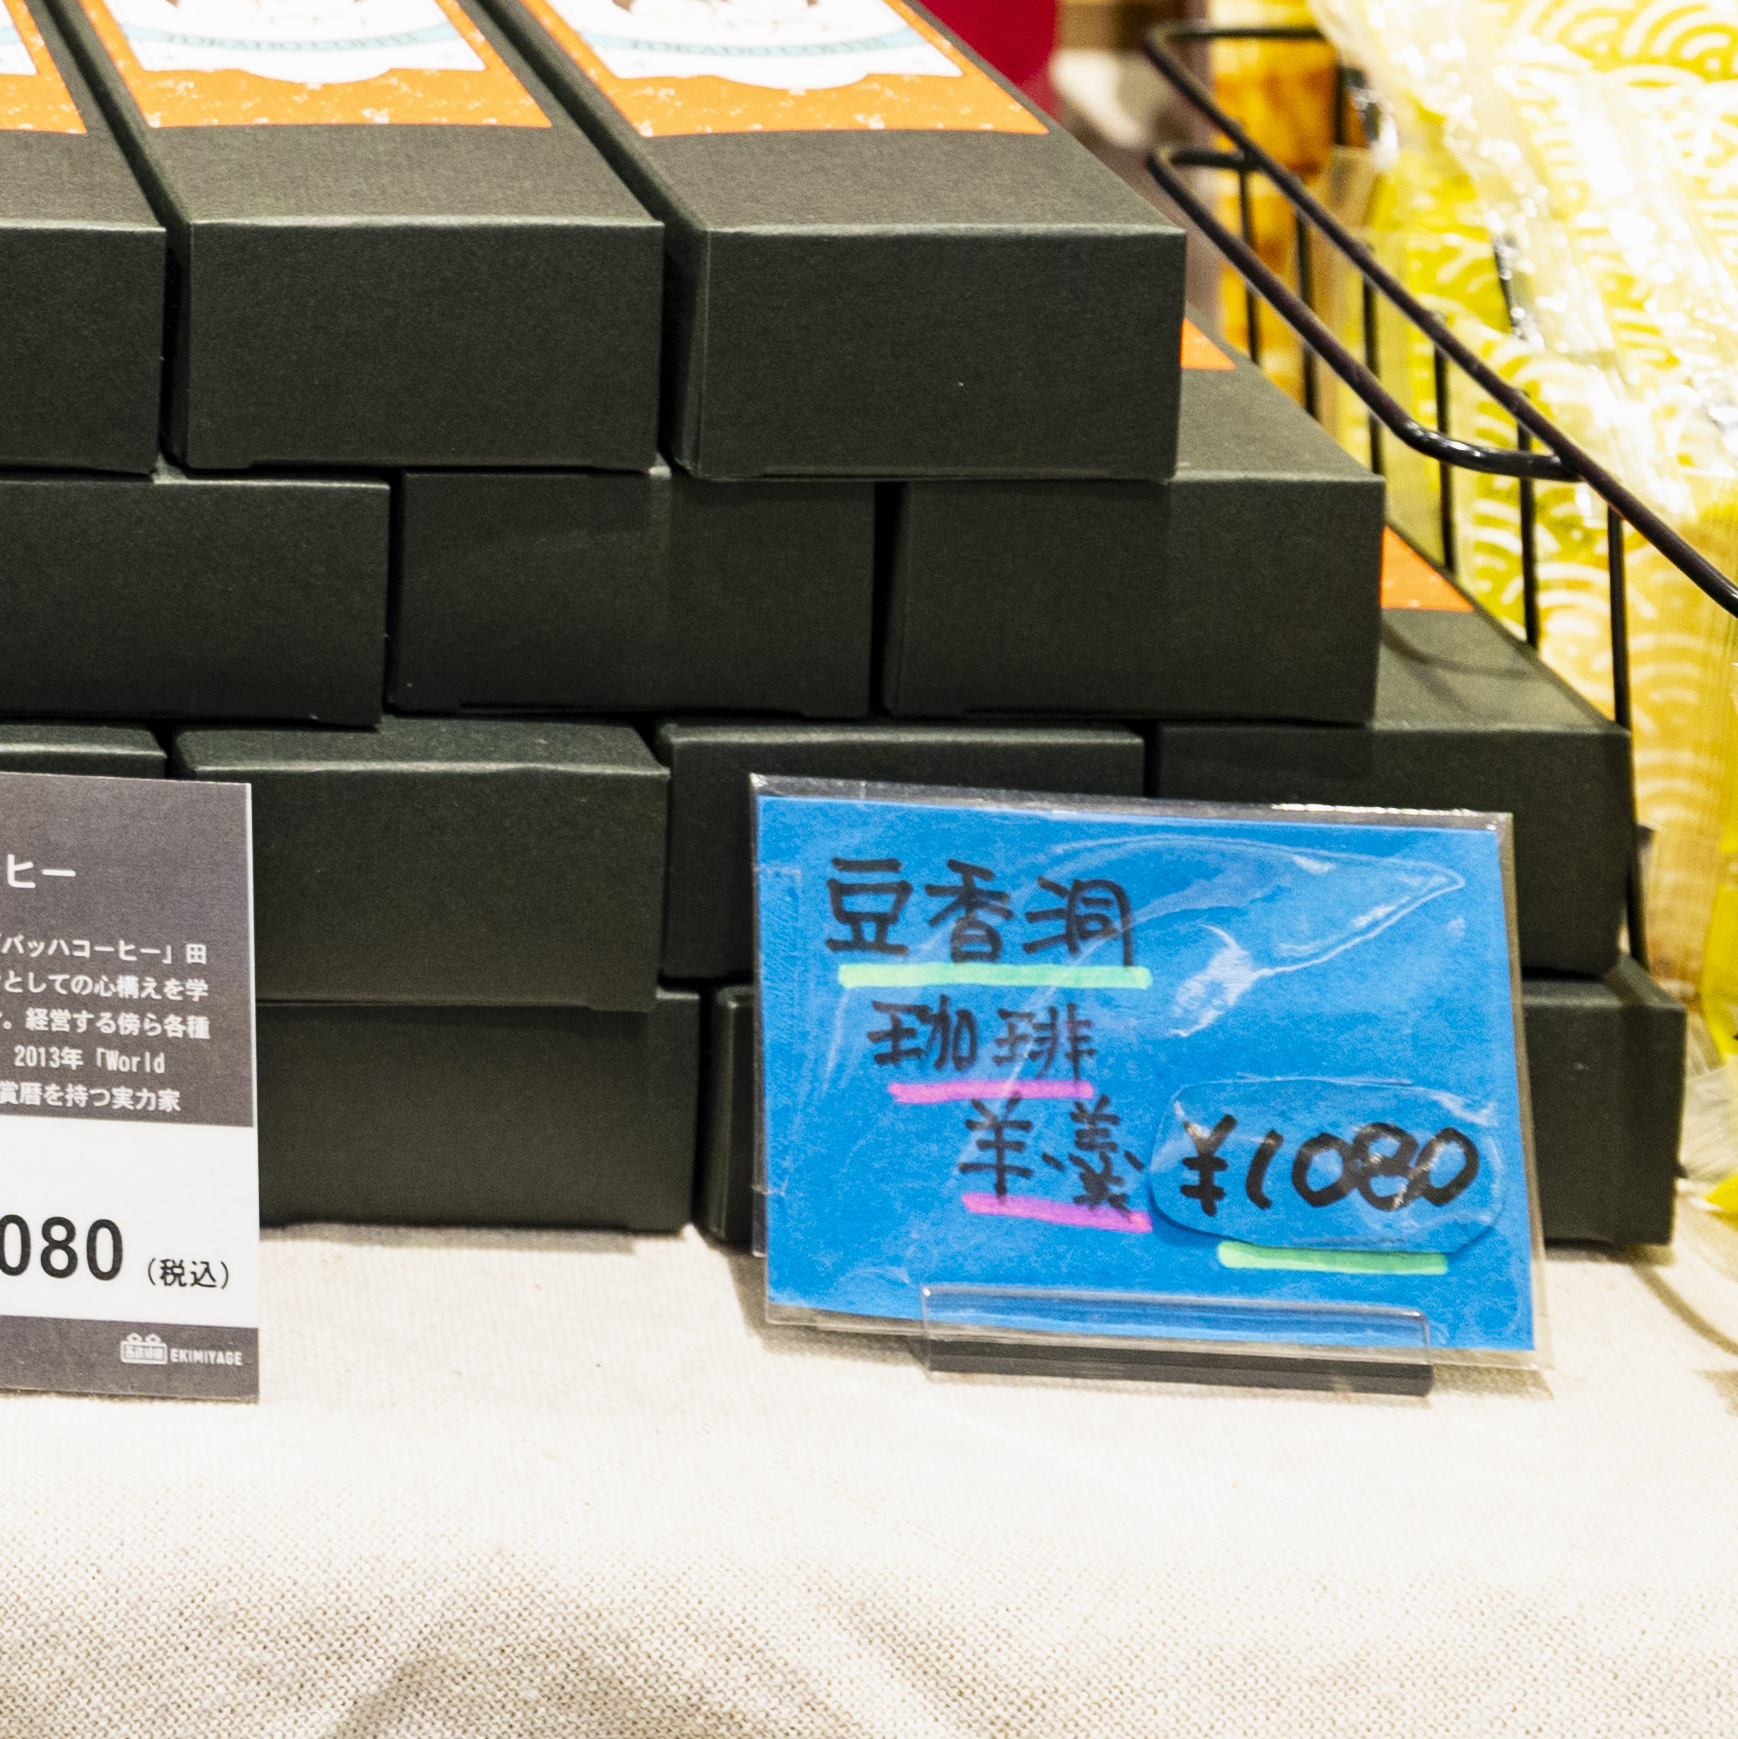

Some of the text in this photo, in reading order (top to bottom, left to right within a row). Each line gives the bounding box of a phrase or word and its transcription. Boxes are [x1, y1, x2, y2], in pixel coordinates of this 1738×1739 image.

[824, 858, 1136, 967] 豆香洞
[867, 995, 1097, 1081] 珈琲
[1181, 1114, 1480, 1217] ¥1080
[170, 1347, 243, 1366] EKIMIYAGE
